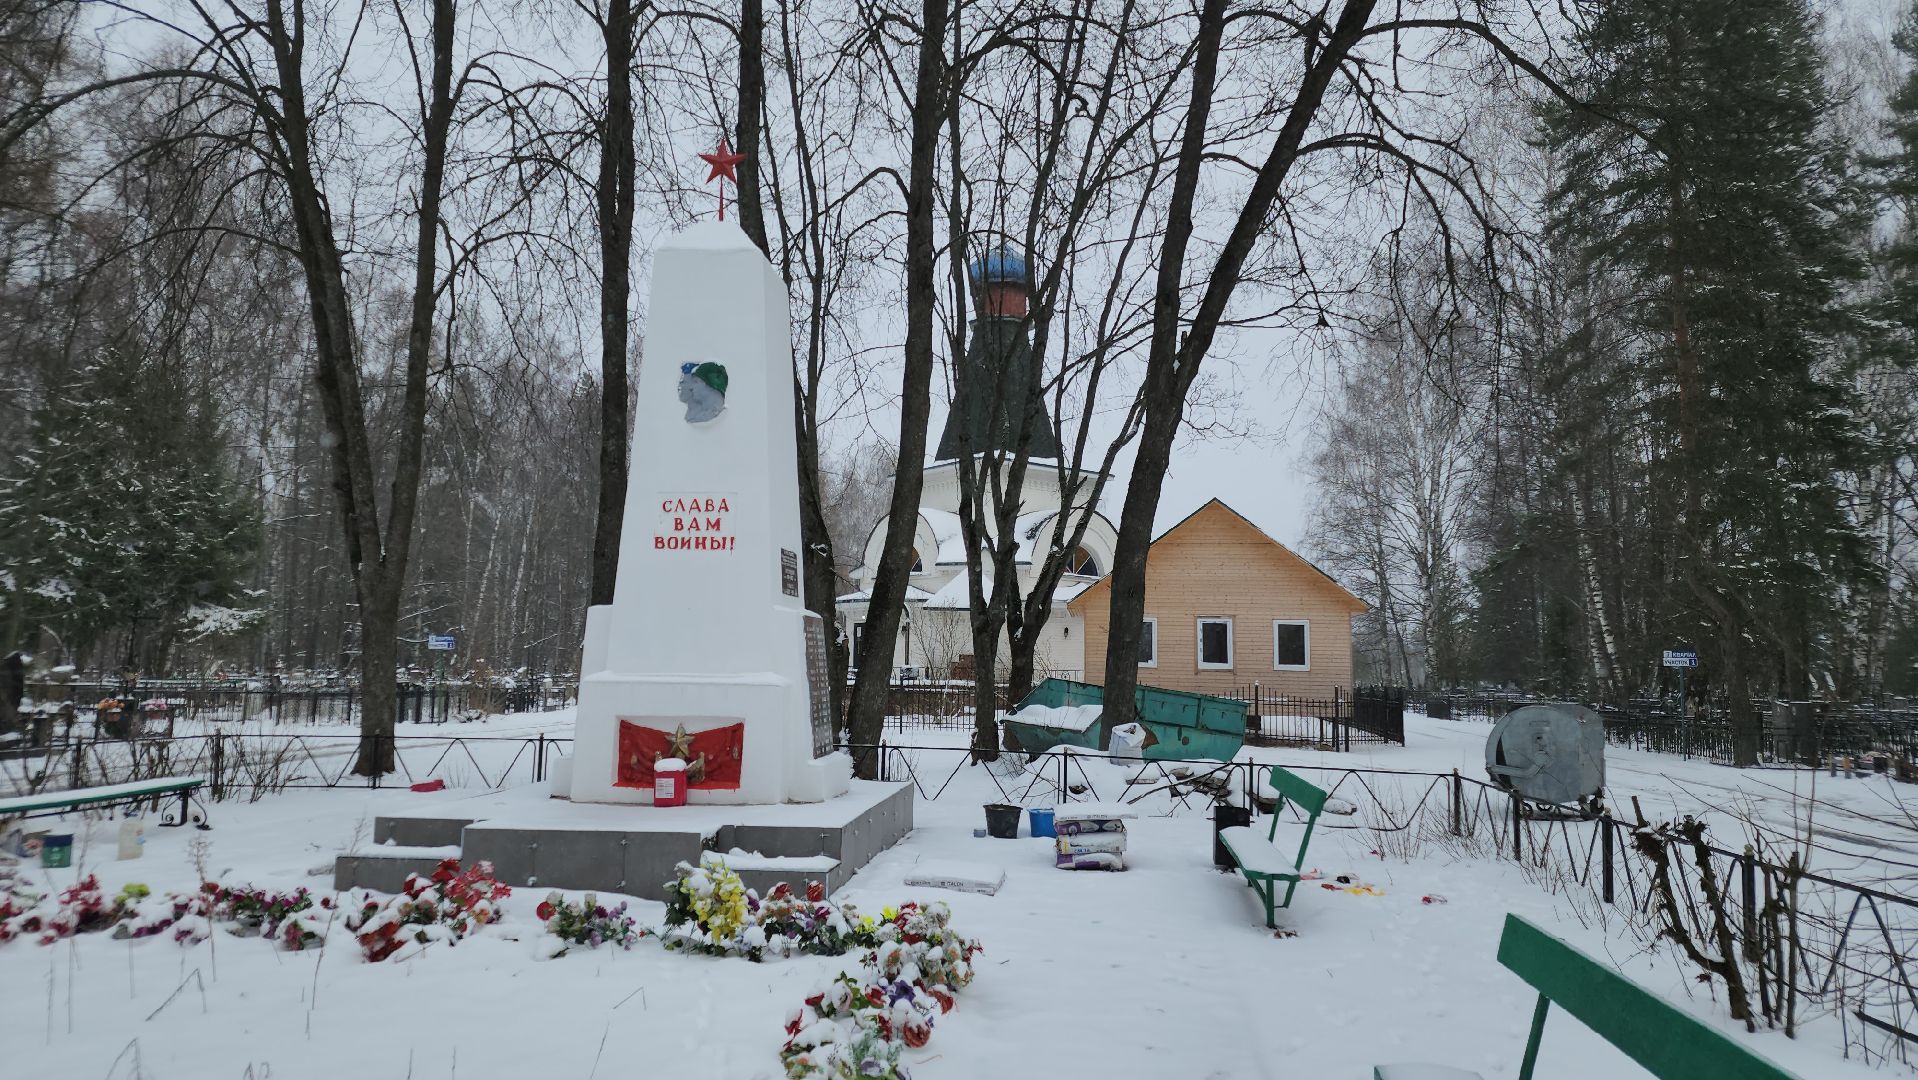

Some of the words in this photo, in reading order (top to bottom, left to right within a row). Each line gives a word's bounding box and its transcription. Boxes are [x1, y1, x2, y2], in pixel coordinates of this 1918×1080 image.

[662, 498, 730, 514] СЛАВА
[673, 516, 722, 532] ВАМ
[654, 536, 735, 551] ВОИНЫ!
